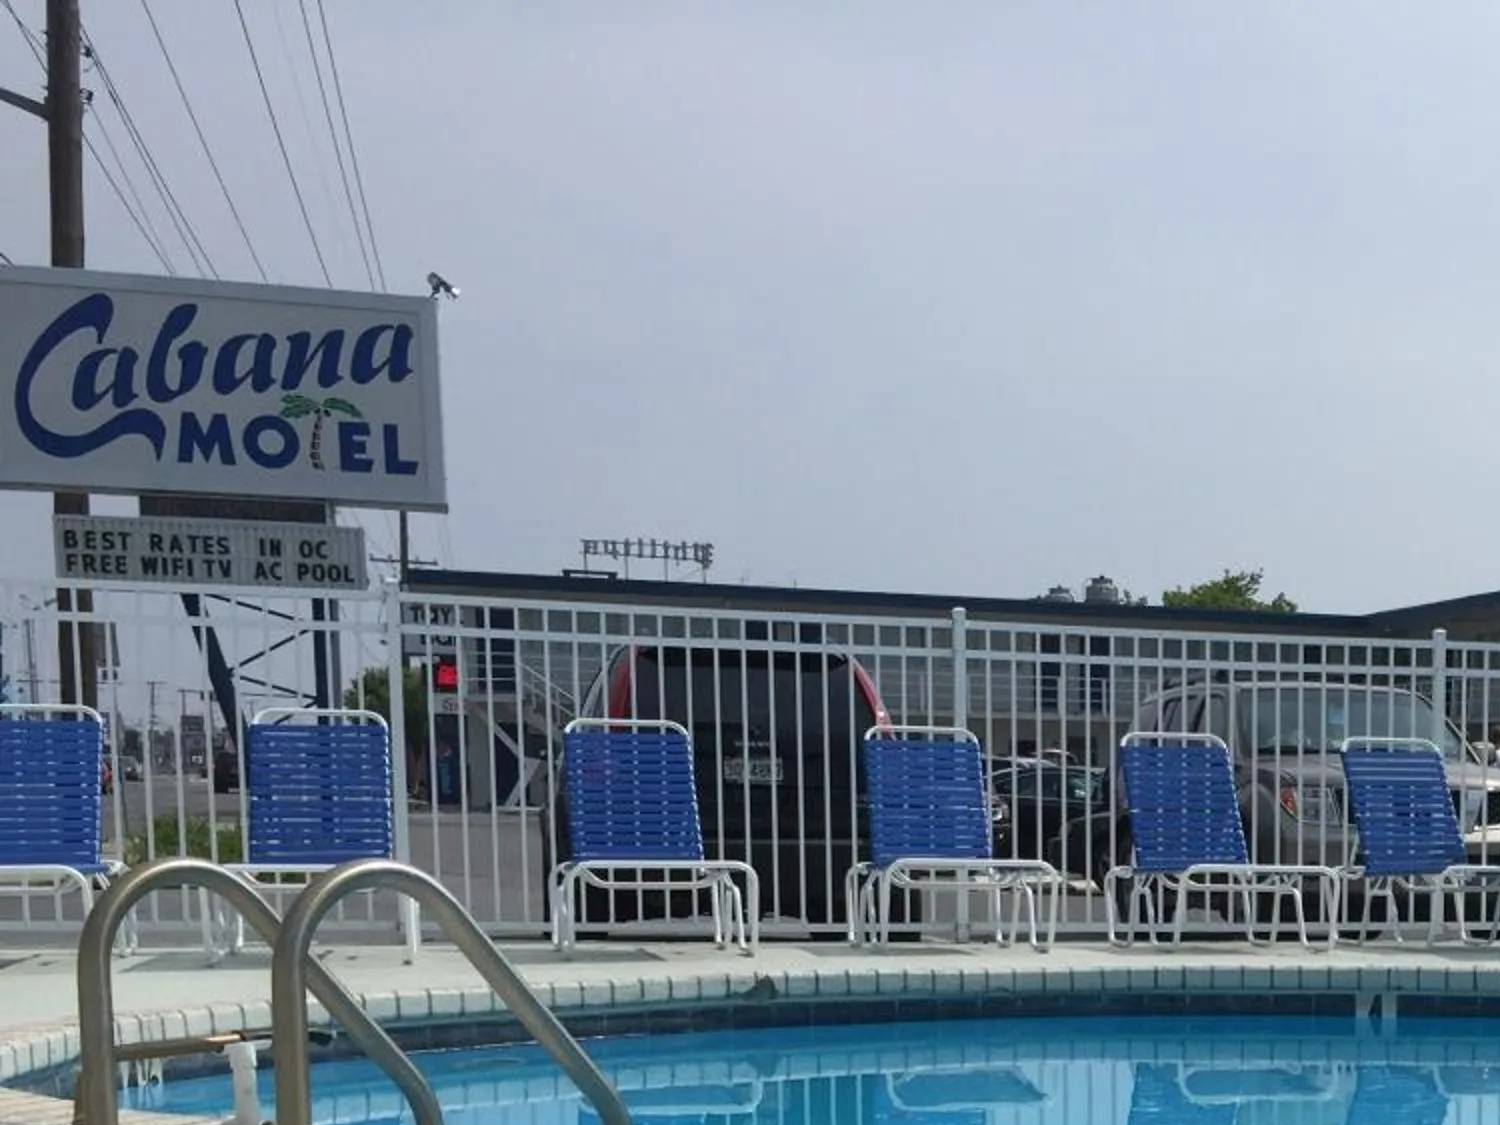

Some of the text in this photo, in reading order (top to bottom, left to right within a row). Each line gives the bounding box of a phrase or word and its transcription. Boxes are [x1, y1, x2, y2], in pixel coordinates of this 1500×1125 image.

[13, 292, 415, 462] Cabana
[177, 396, 419, 477] MOTEL
[63, 529, 329, 560] BEST RATES IN OC
[66, 553, 356, 584] FREE WIFI TV AC POOL
